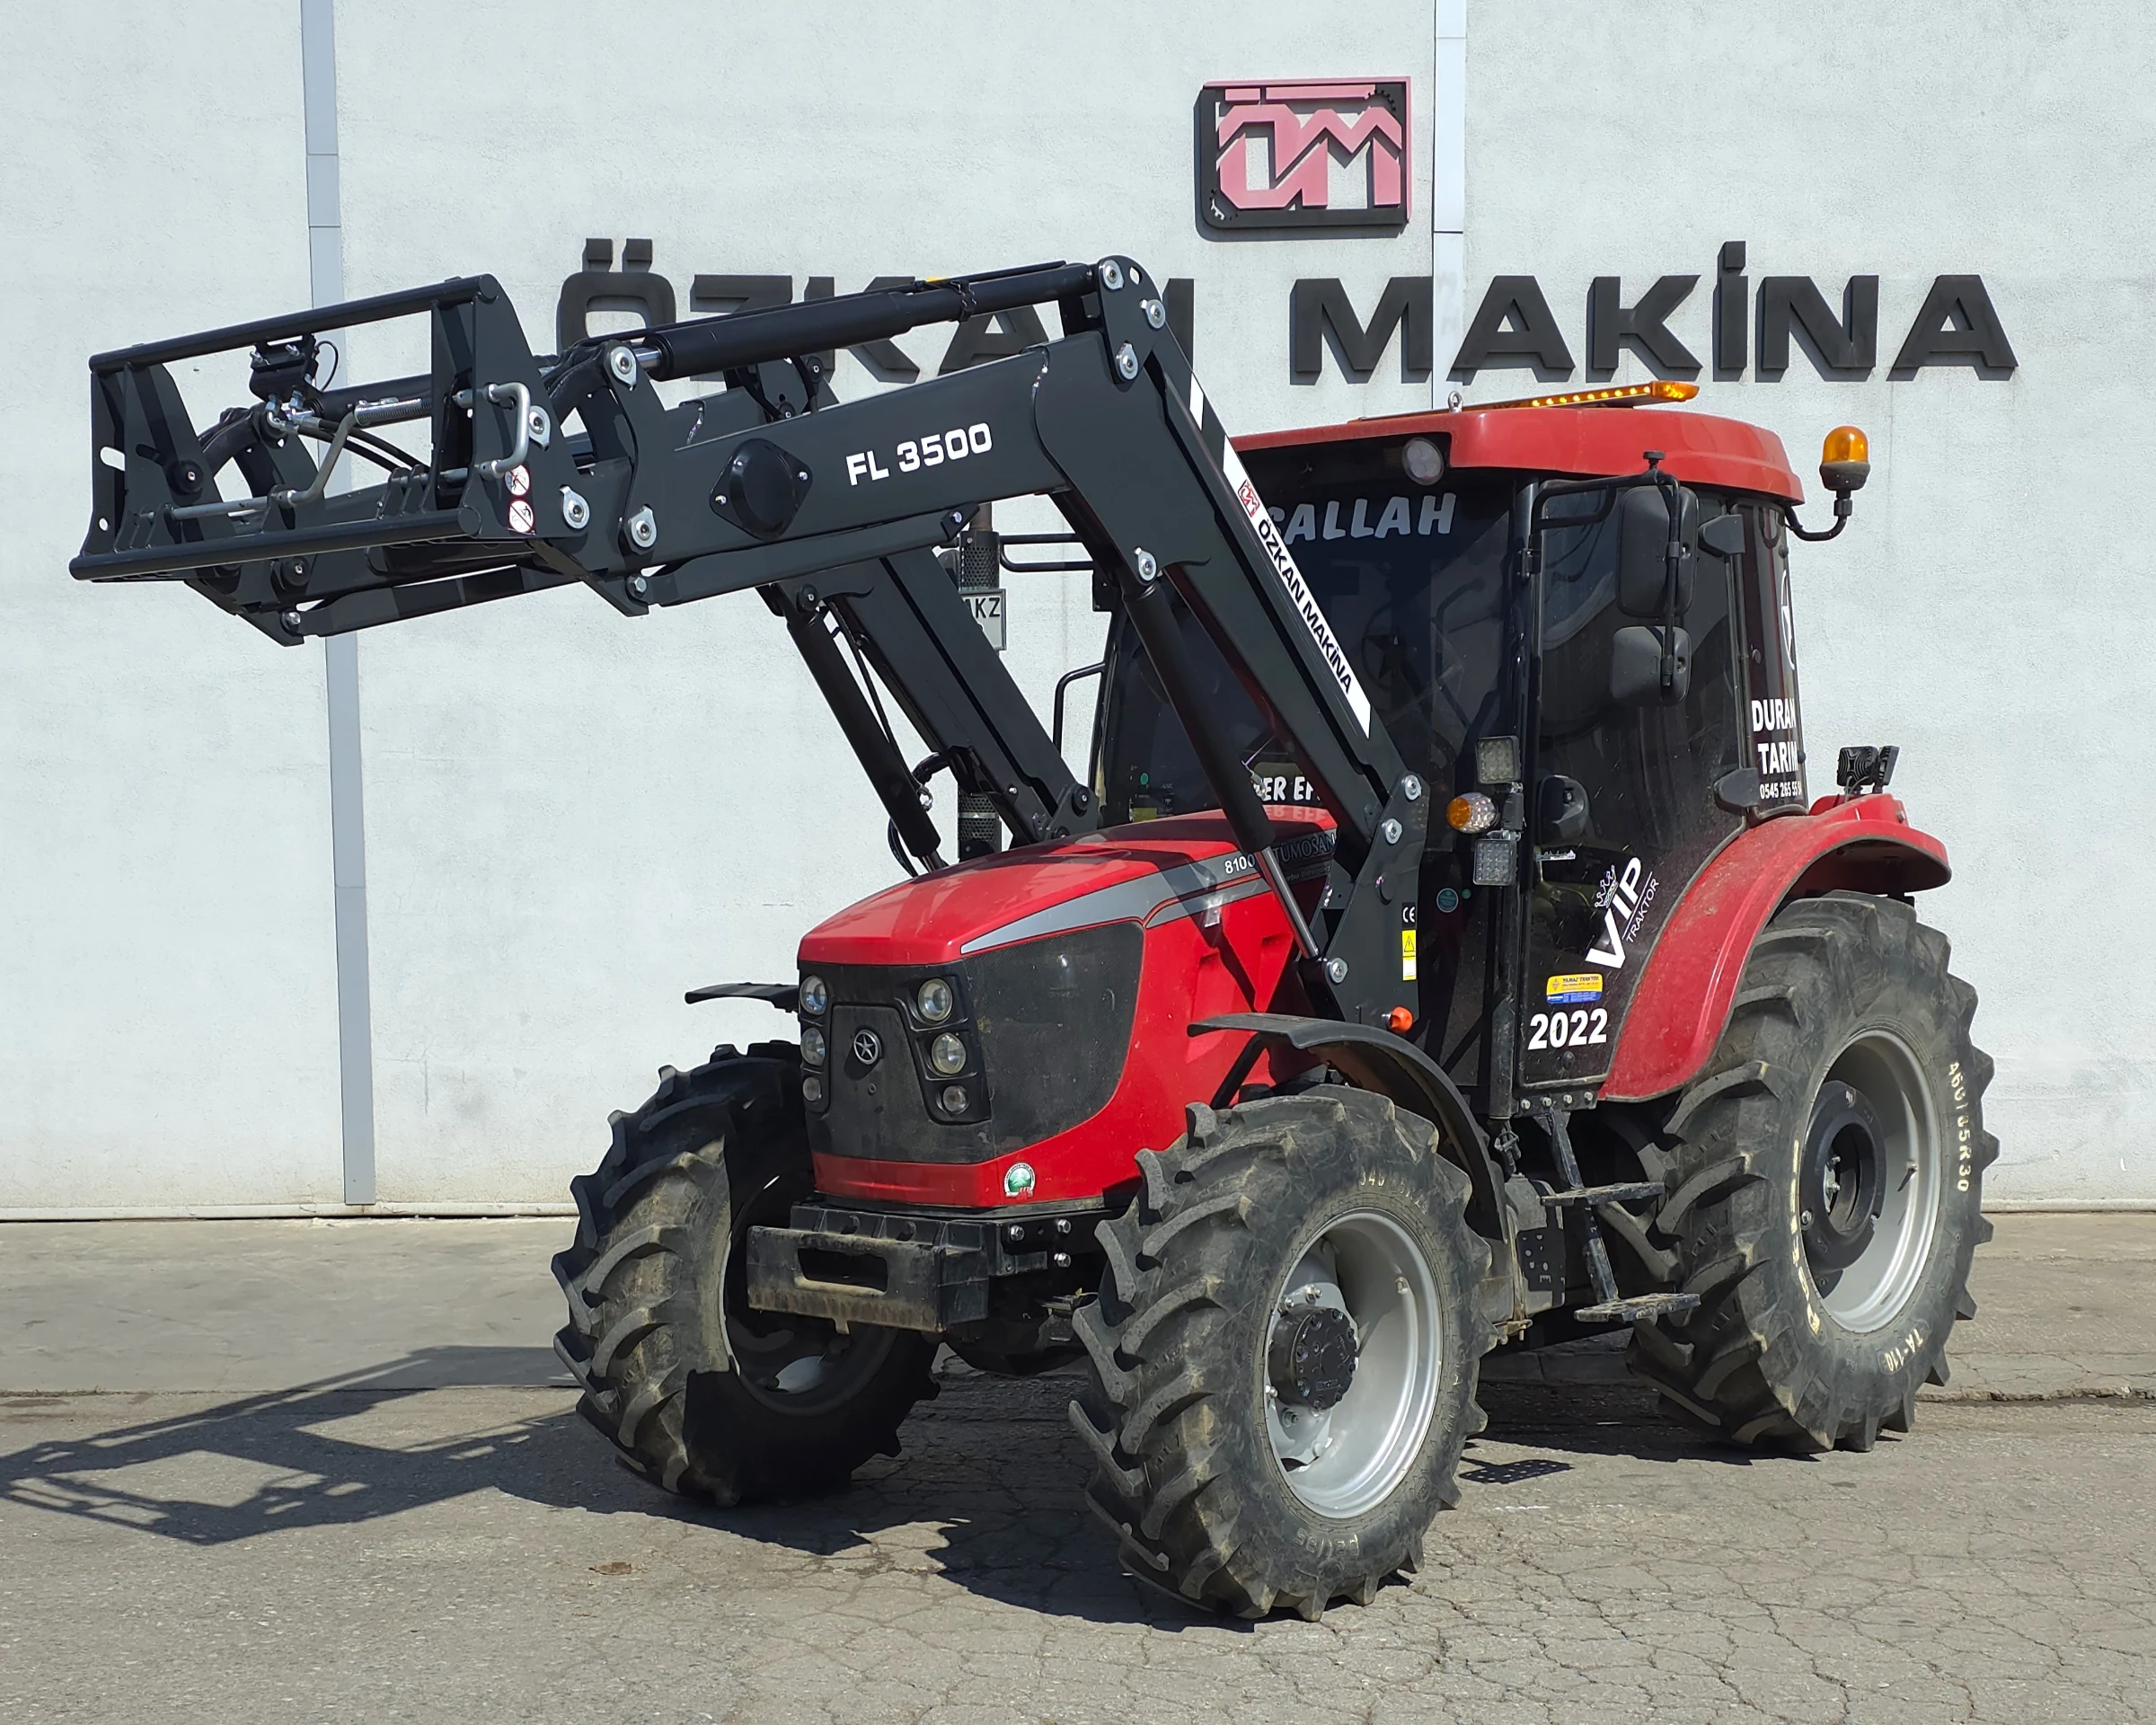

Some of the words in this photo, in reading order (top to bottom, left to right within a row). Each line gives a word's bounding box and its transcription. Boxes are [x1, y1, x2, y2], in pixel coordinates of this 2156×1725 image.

[1292, 240, 2019, 381] MAKİNA
[846, 450, 889, 486] FL
[897, 422, 993, 473] 3500
[1259, 518, 1305, 604] ÖZKAN
[1303, 601, 1352, 694] MAKİNA
[1759, 783, 1779, 800] 0545
[1780, 781, 1791, 798] 265
[1224, 854, 1255, 874] 8100
[1402, 906, 1415, 923] CE
[1585, 856, 1642, 969] VIP
[1627, 878, 1660, 943] TRAKTOR
[1528, 1008, 1608, 1050] 2022
